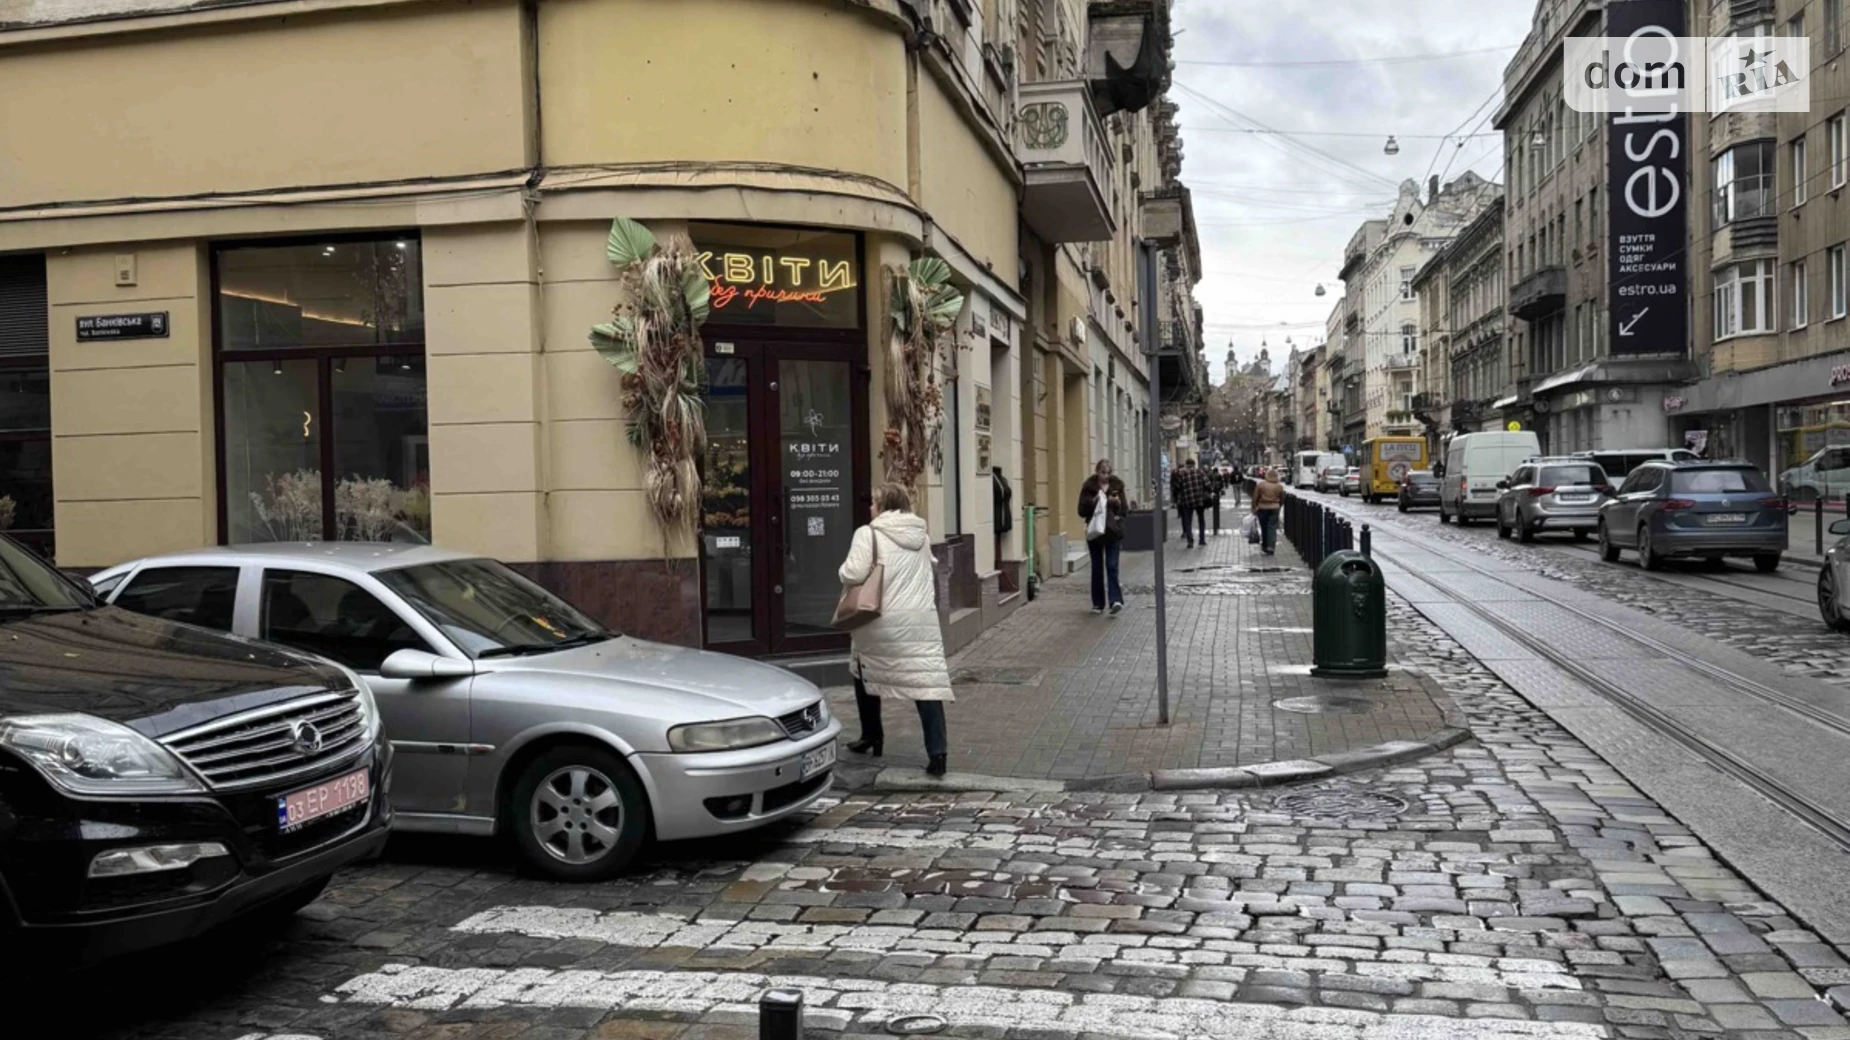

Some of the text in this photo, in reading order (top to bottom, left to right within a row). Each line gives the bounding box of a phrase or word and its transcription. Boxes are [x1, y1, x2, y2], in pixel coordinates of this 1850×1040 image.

[1612, 25, 1680, 218] estro
[1619, 233, 1656, 243] ВЗУТТЯ
[1619, 244, 1654, 253] СУМКИ
[1619, 254, 1645, 263] ОДЯГ
[1619, 262, 1677, 273] АКСЕСУАРИ
[710, 274, 740, 308] без
[1618, 284, 1677, 296] estro.ua
[789, 443, 840, 453] КВІТИ
[790, 469, 840, 478] 09:00-21:00
[288, 800, 304, 821] 03
[306, 786, 328, 813] EP
[333, 773, 365, 803] 1198
